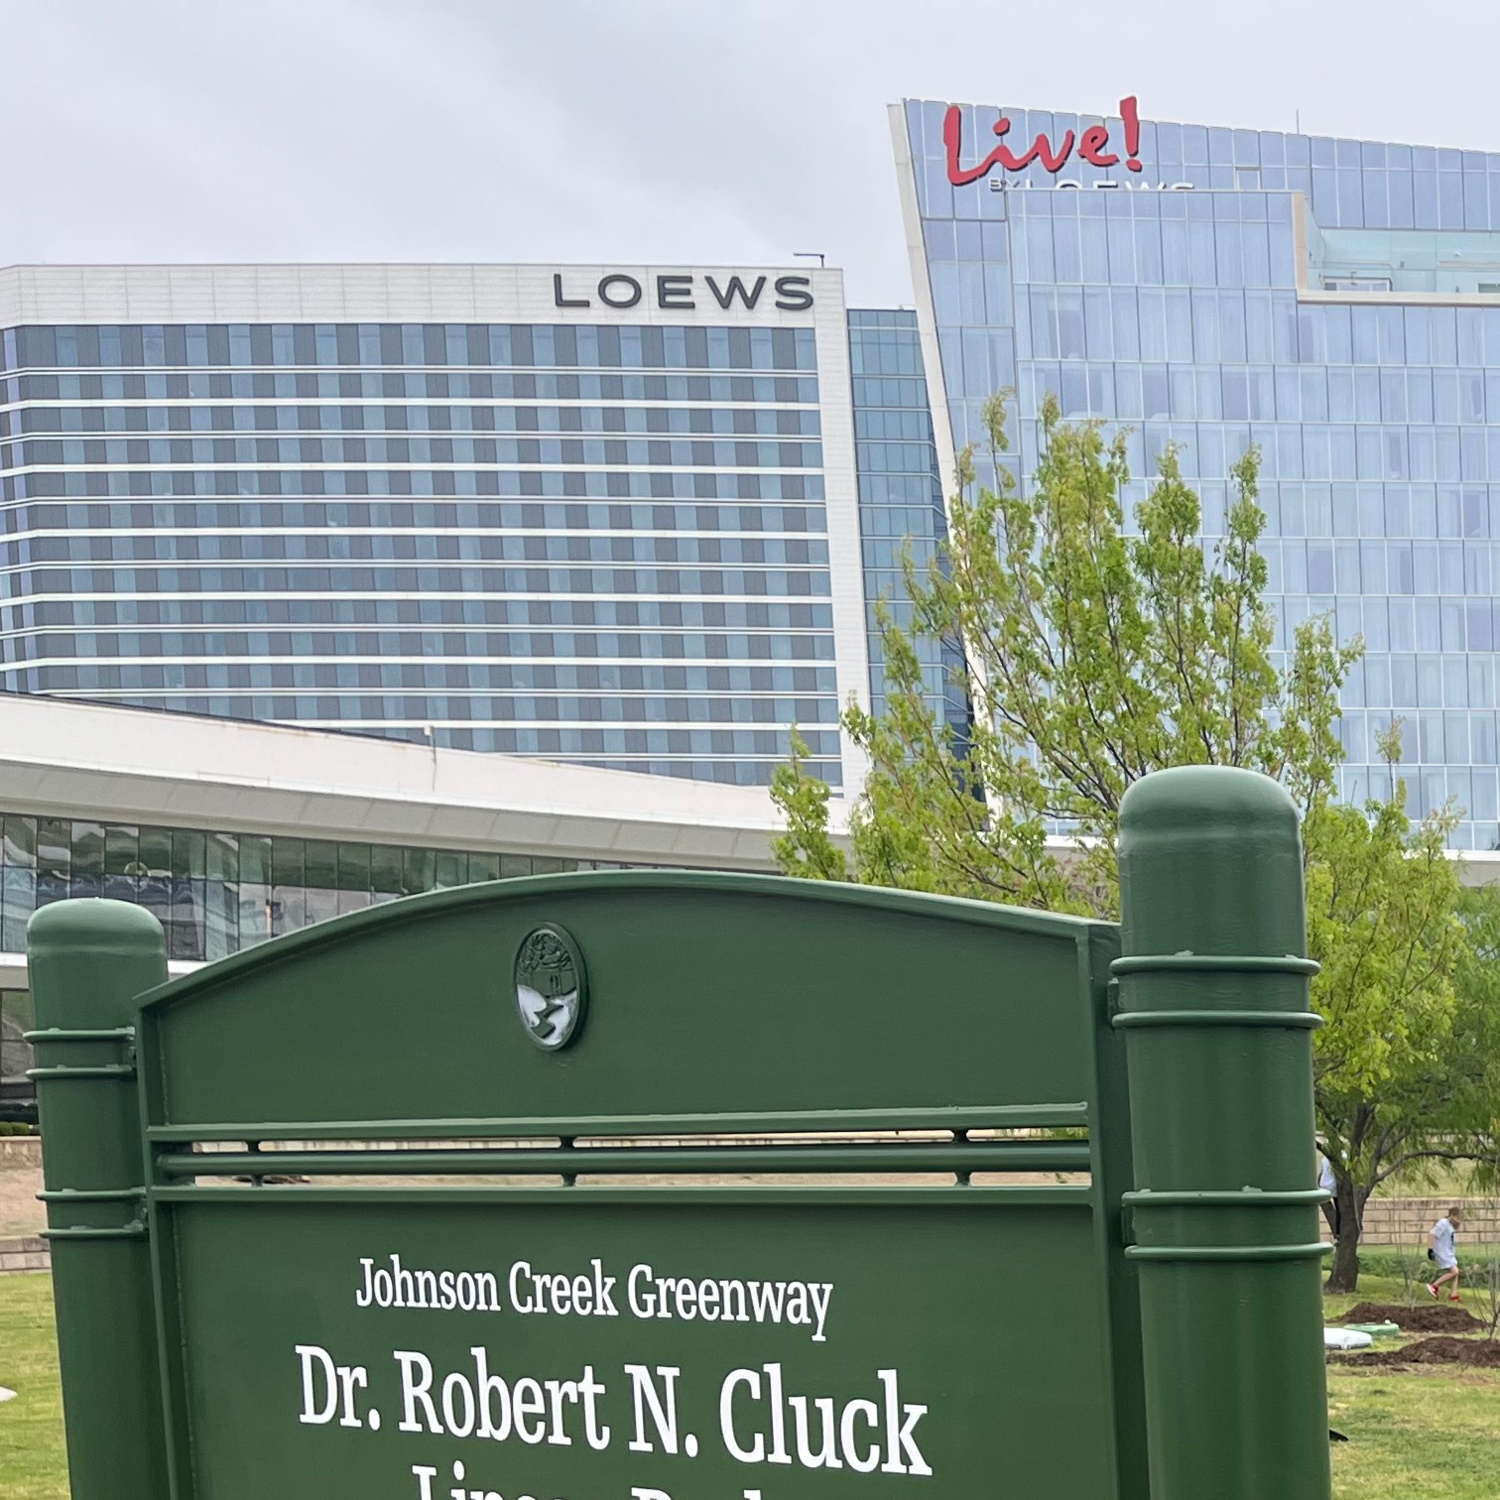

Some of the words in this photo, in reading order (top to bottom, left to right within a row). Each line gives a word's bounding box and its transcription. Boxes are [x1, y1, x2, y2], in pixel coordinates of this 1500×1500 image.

[943, 95, 1142, 187] Live!
[553, 273, 814, 310] LOEWS
[355, 1253, 502, 1312] Johnson
[509, 1258, 619, 1316] Creek
[627, 1264, 834, 1342] Greenway
[295, 1345, 381, 1431] Dr.
[393, 1346, 611, 1450] Robert
[624, 1364, 699, 1458] N.
[719, 1362, 933, 1476] Cluck
